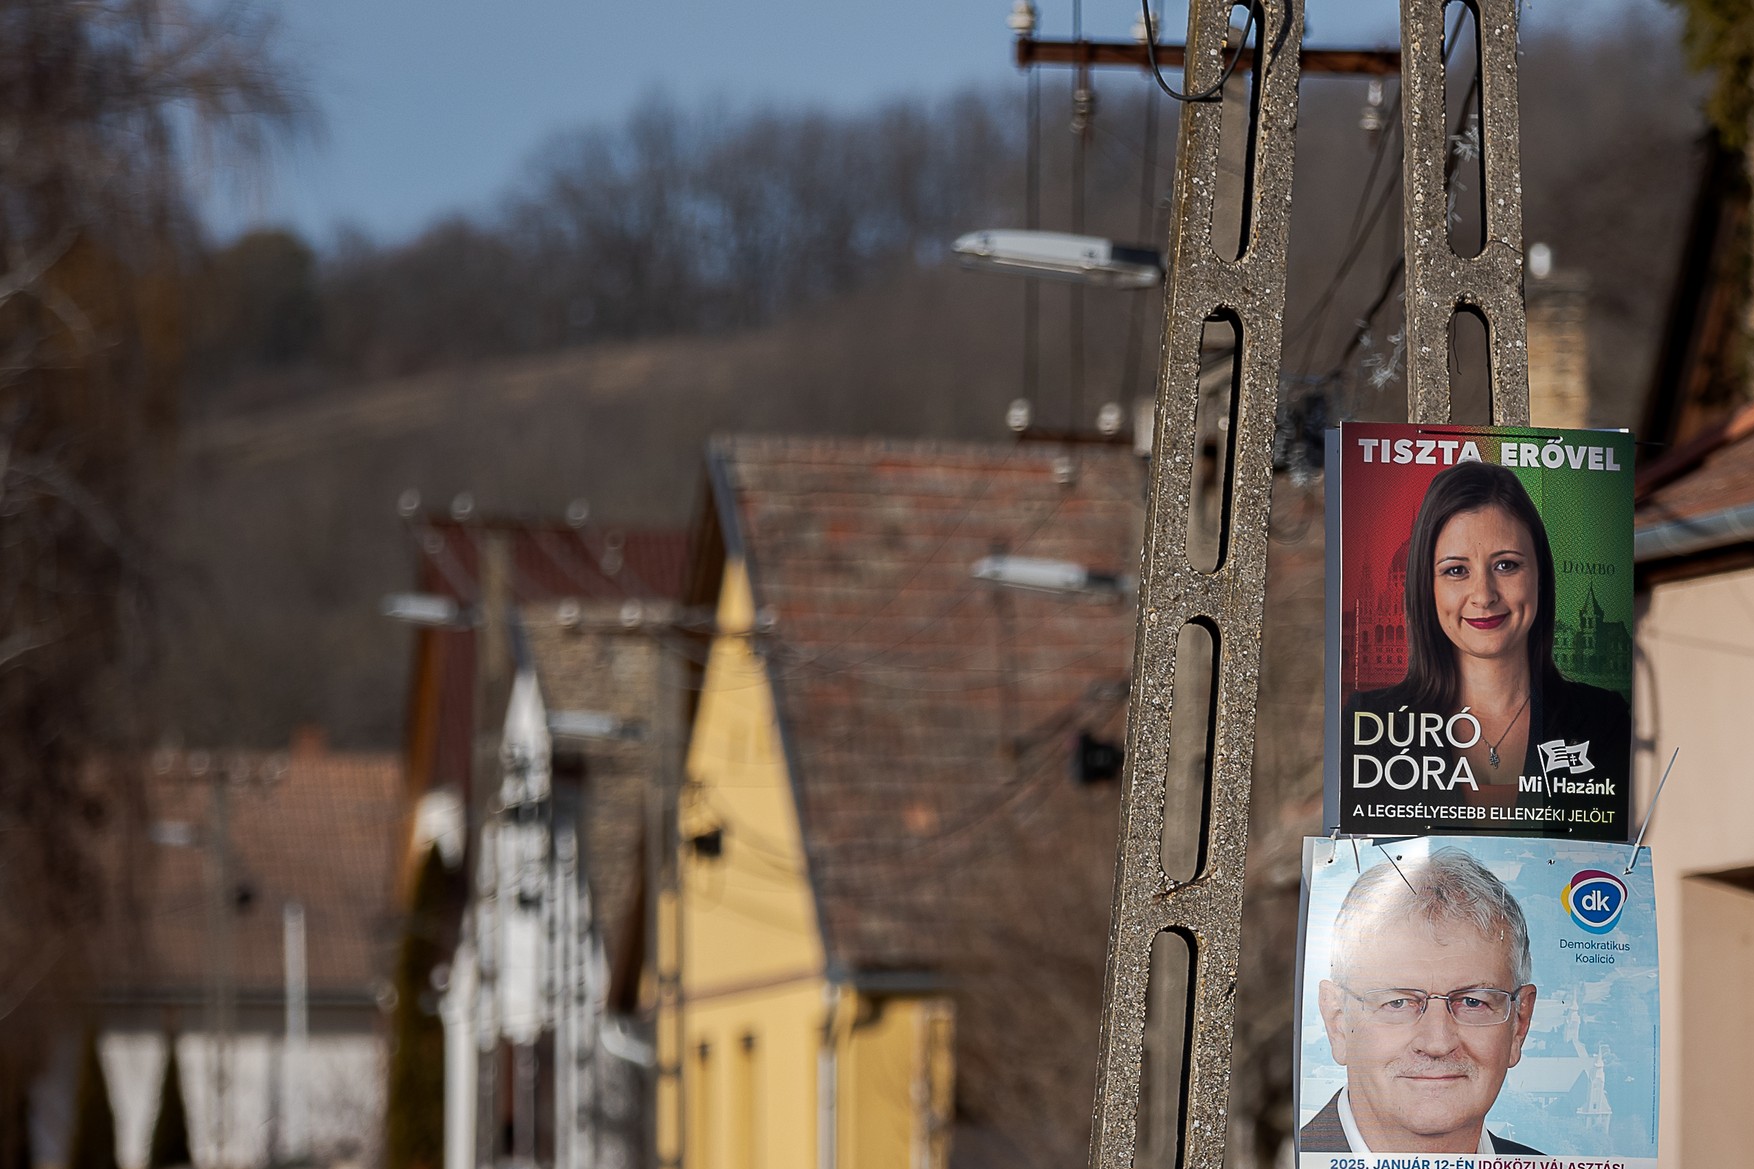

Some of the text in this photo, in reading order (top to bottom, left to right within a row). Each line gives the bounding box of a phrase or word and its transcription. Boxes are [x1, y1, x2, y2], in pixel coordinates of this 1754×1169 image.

[1357, 437, 1621, 471] TISZTA ERŐVEL
[1353, 706, 1481, 748] DÚRÓ
[1352, 748, 1479, 792] DÓRA
[1518, 772, 1616, 796] Mi Hazánk
[1352, 801, 1615, 824] A LEGESÉLYESEBB ELLENZÉKI JELÖLT
[1581, 888, 1611, 913] dk
[1559, 937, 1631, 953] Demokratikus
